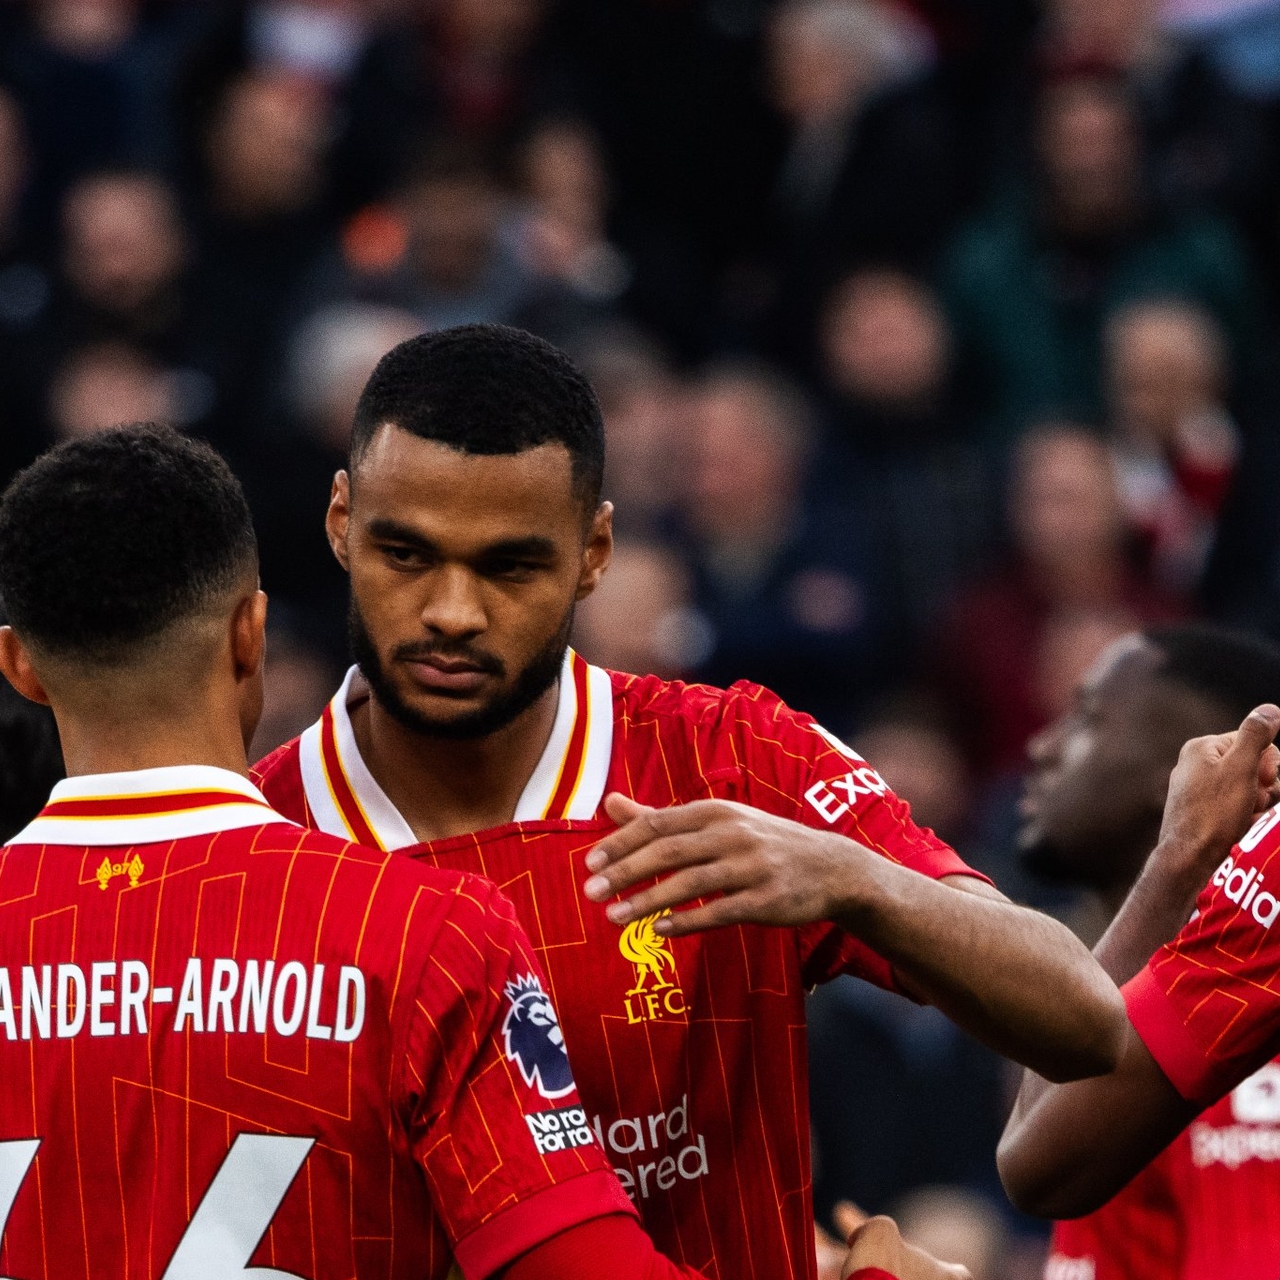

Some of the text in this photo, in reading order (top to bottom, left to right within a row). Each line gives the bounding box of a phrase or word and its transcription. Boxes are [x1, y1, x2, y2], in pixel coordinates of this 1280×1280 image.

[804, 767, 892, 824] Exp
[525, 1108, 587, 1133] No ro
[533, 1130, 566, 1155] for
